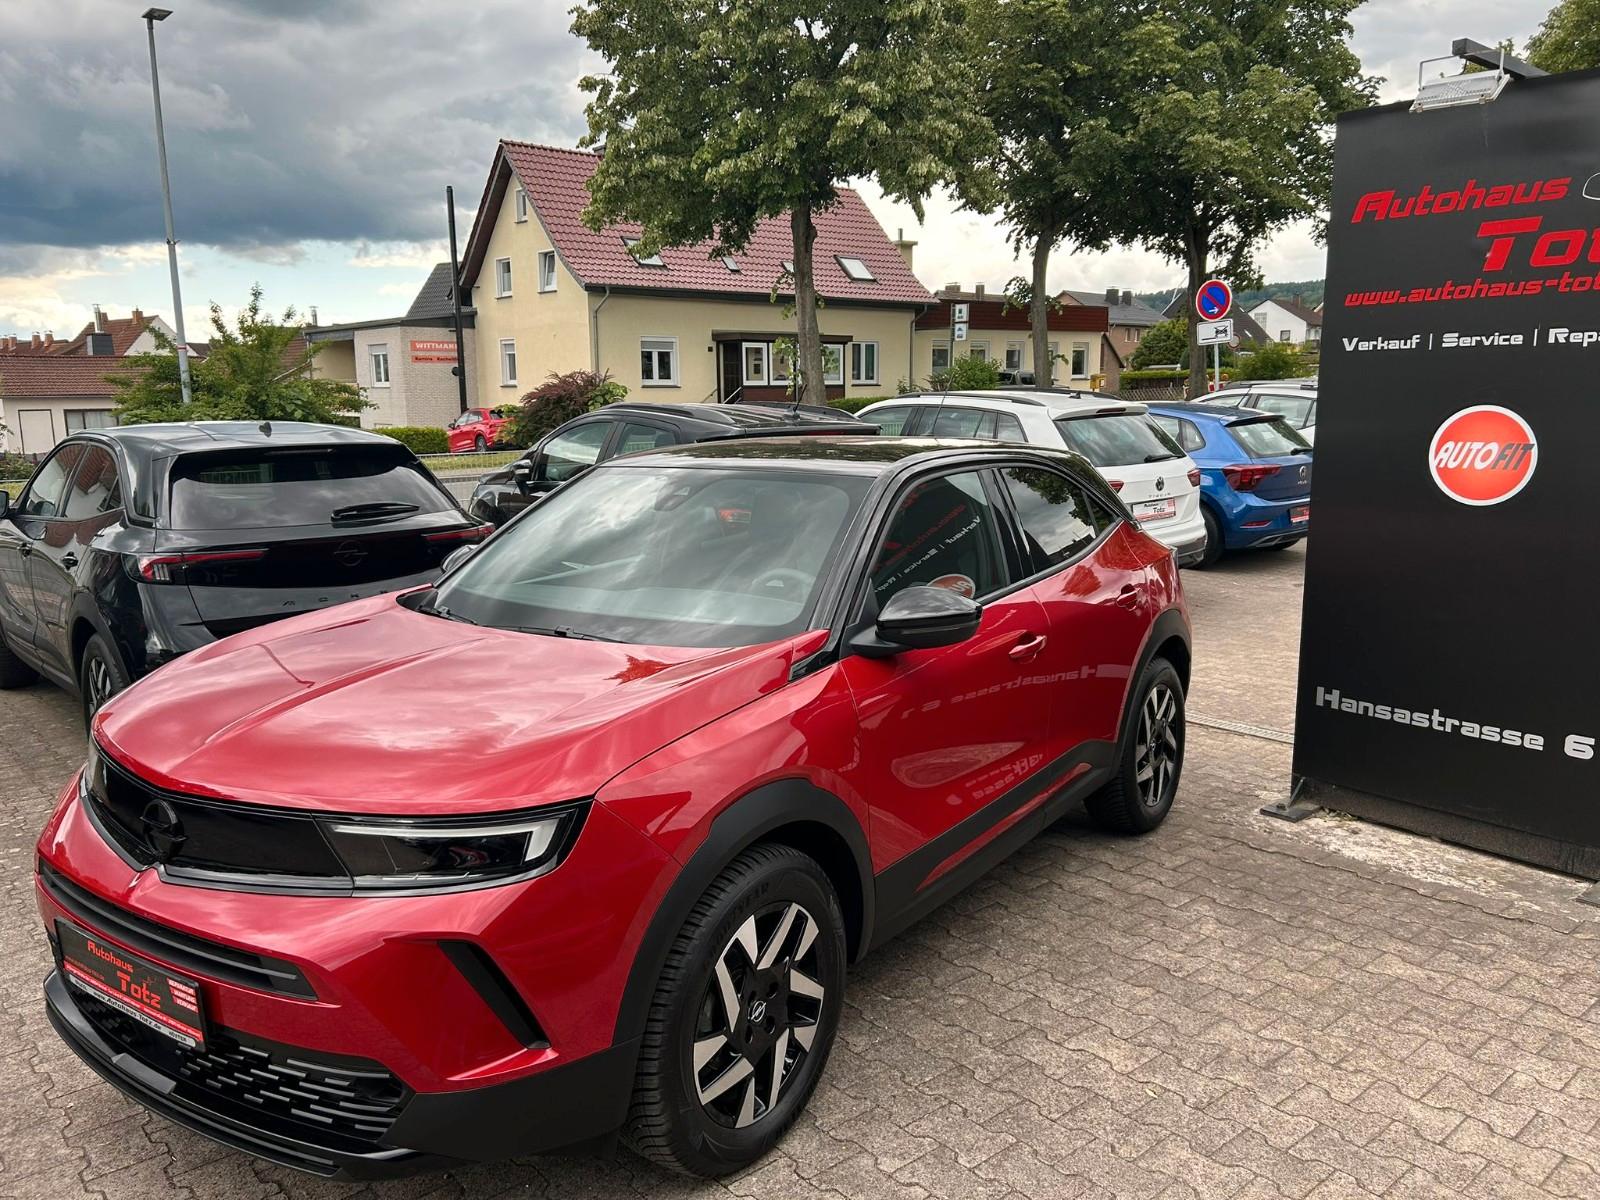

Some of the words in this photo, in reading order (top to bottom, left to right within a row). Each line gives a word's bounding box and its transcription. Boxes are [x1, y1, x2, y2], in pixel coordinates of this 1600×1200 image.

[1351, 177, 1572, 223] Autohaus
[1342, 334, 1421, 352] Verkauf
[1441, 332, 1524, 348] Service
[1547, 327, 1600, 347] Rep
[1434, 440, 1535, 471] AUTOFIT
[1315, 686, 1544, 751] Hansastrasse
[1564, 734, 1596, 760] 6
[87, 940, 134, 973] Autohaus
[117, 971, 161, 1008] Totz
